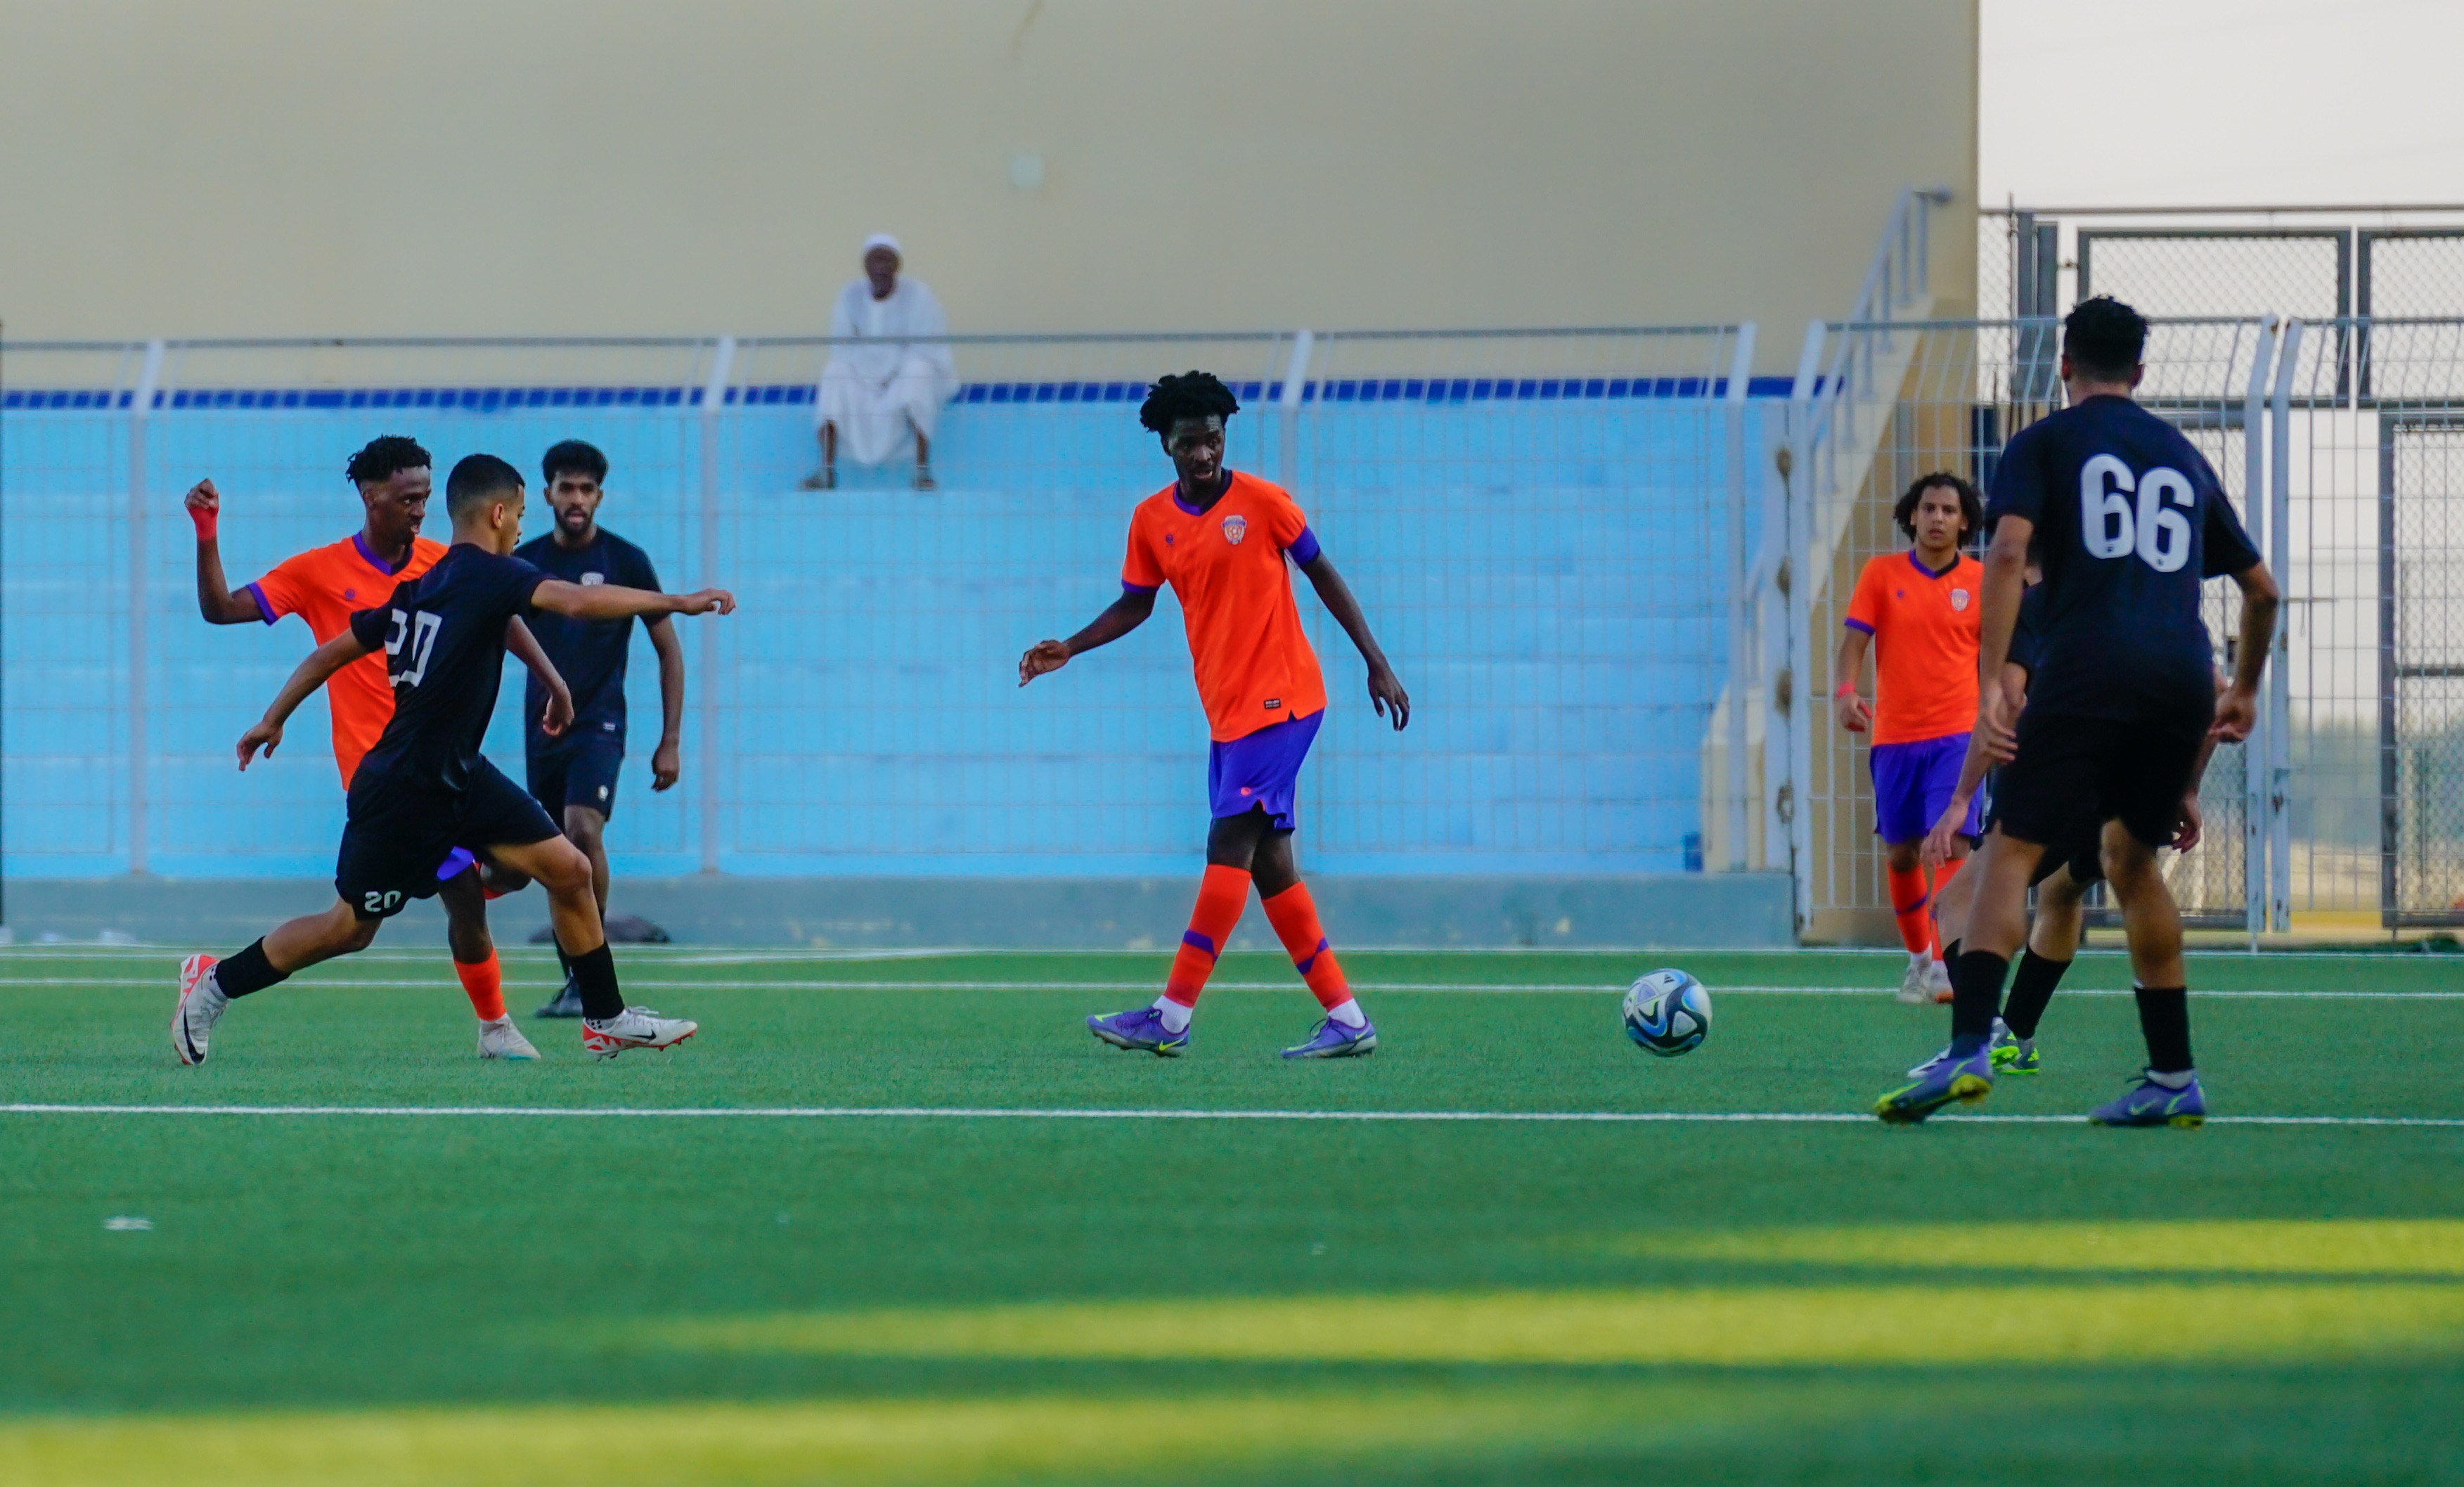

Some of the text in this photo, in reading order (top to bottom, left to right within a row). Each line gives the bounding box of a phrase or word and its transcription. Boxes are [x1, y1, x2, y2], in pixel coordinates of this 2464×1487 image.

[2080, 453, 2195, 572] 66
[384, 608, 442, 688] 20
[364, 890, 401, 913] 20
